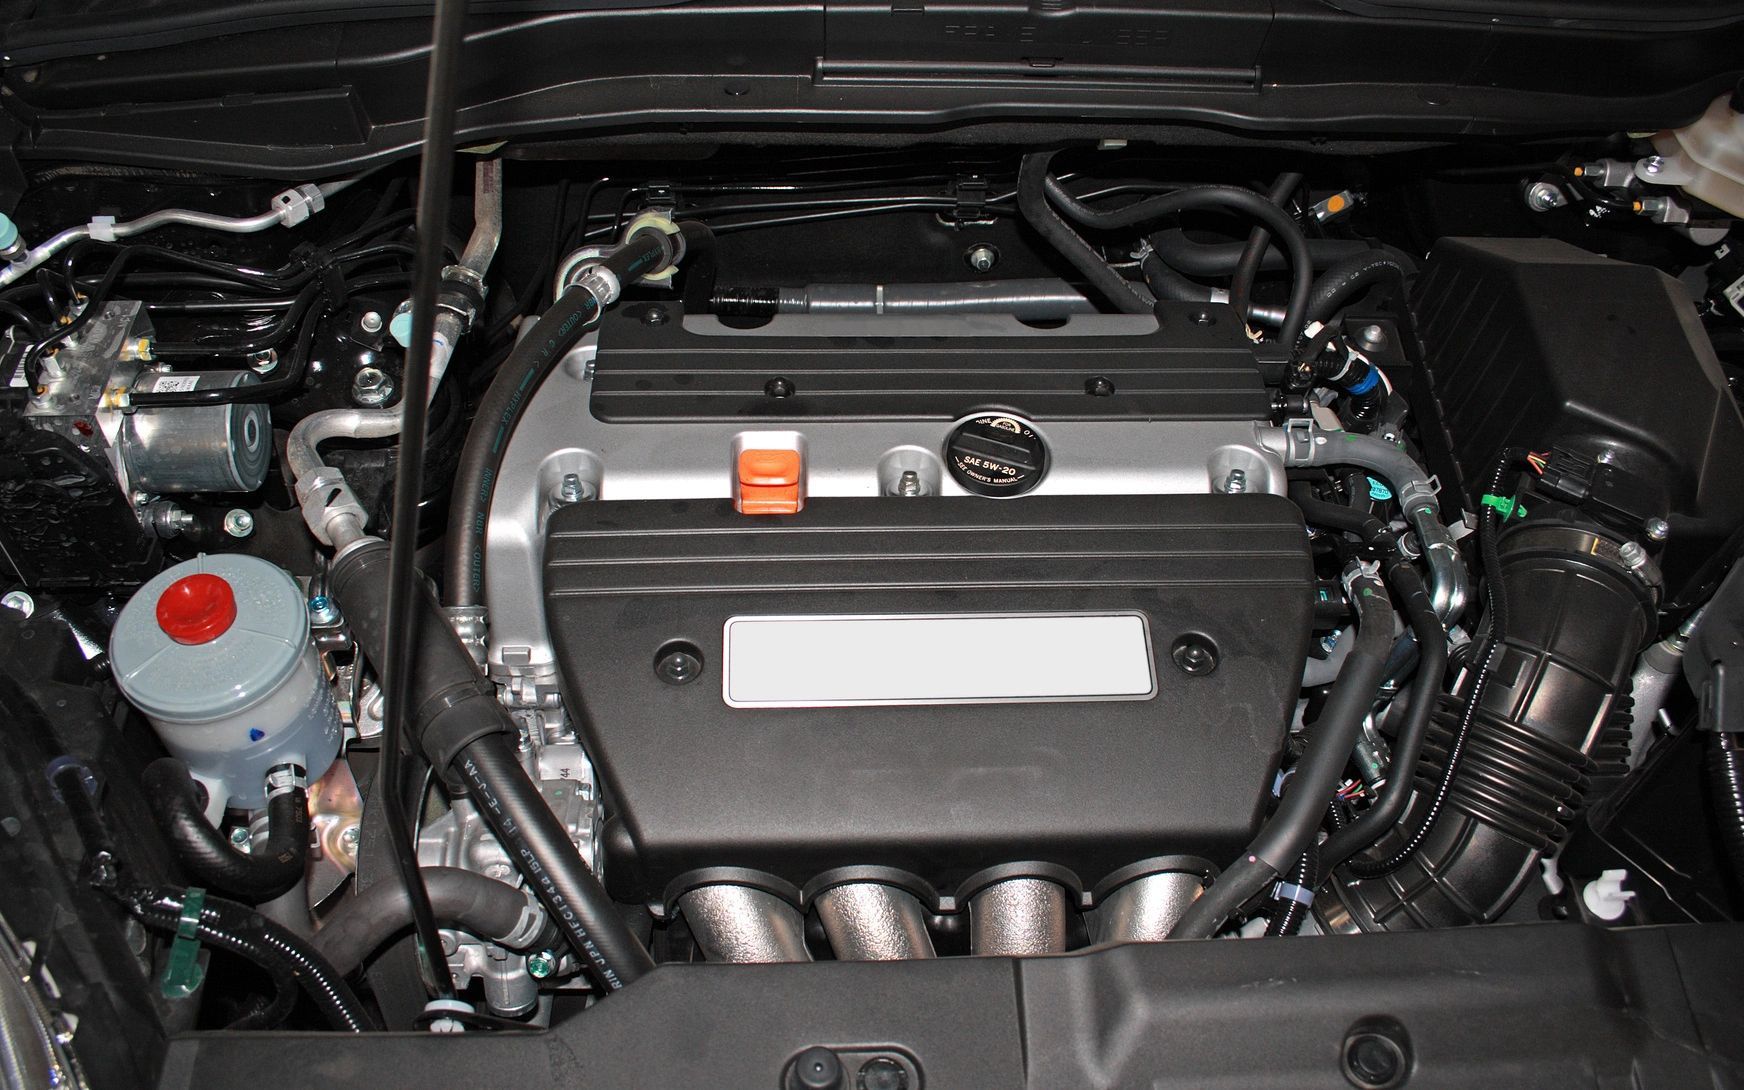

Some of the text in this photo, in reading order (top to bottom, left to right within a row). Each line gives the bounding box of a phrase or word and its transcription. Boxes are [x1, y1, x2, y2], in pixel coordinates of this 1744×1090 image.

[963, 455, 1016, 476] SAE 5W-20
[966, 467, 991, 483] OWNER'S
[993, 476, 1018, 484] MANUAL
[581, 939, 606, 966] JPN
